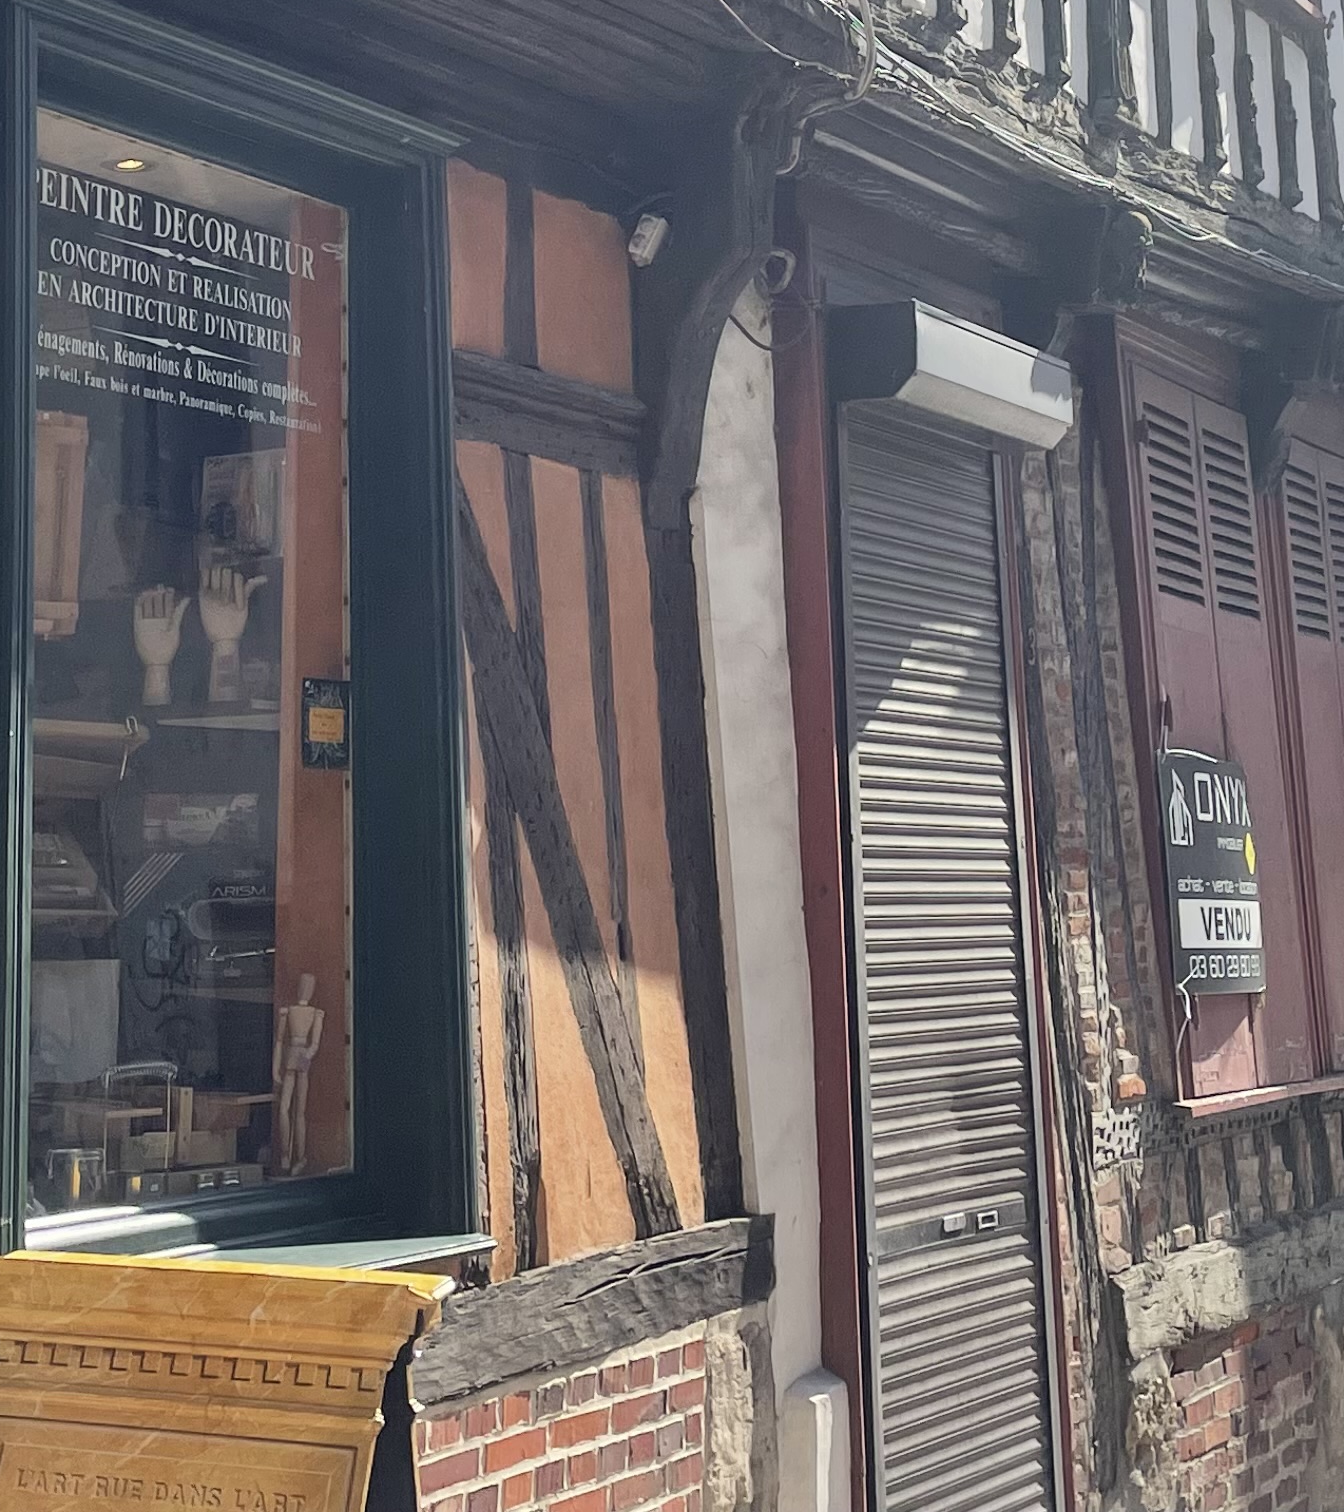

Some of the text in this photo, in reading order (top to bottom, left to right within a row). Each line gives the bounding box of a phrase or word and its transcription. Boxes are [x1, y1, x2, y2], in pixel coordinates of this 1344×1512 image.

[36, 167, 316, 281] EINTRE DECORATEUR
[50, 237, 292, 322] CONCEPTION ET REALISATION
[37, 270, 302, 358] EN ARCHITECTURE D'INTERIEUR
[84, 370, 107, 390] Faux
[110, 375, 129, 394] bois
[131, 381, 141, 397] et
[143, 384, 178, 406] marbre,
[179, 392, 236, 420] Panoramique,
[113, 340, 180, 378] Rénovations
[183, 358, 193, 381] &
[197, 361, 259, 396] Décorations
[1193, 772, 1252, 827] ONYX
[1200, 906, 1252, 941] VENDU
[1189, 955, 1207, 979] 03
[1209, 954, 1226, 979] 60
[17, 1467, 85, 1497] L'ART
[95, 1474, 145, 1501] RUE
[154, 1481, 223, 1509] DANS
